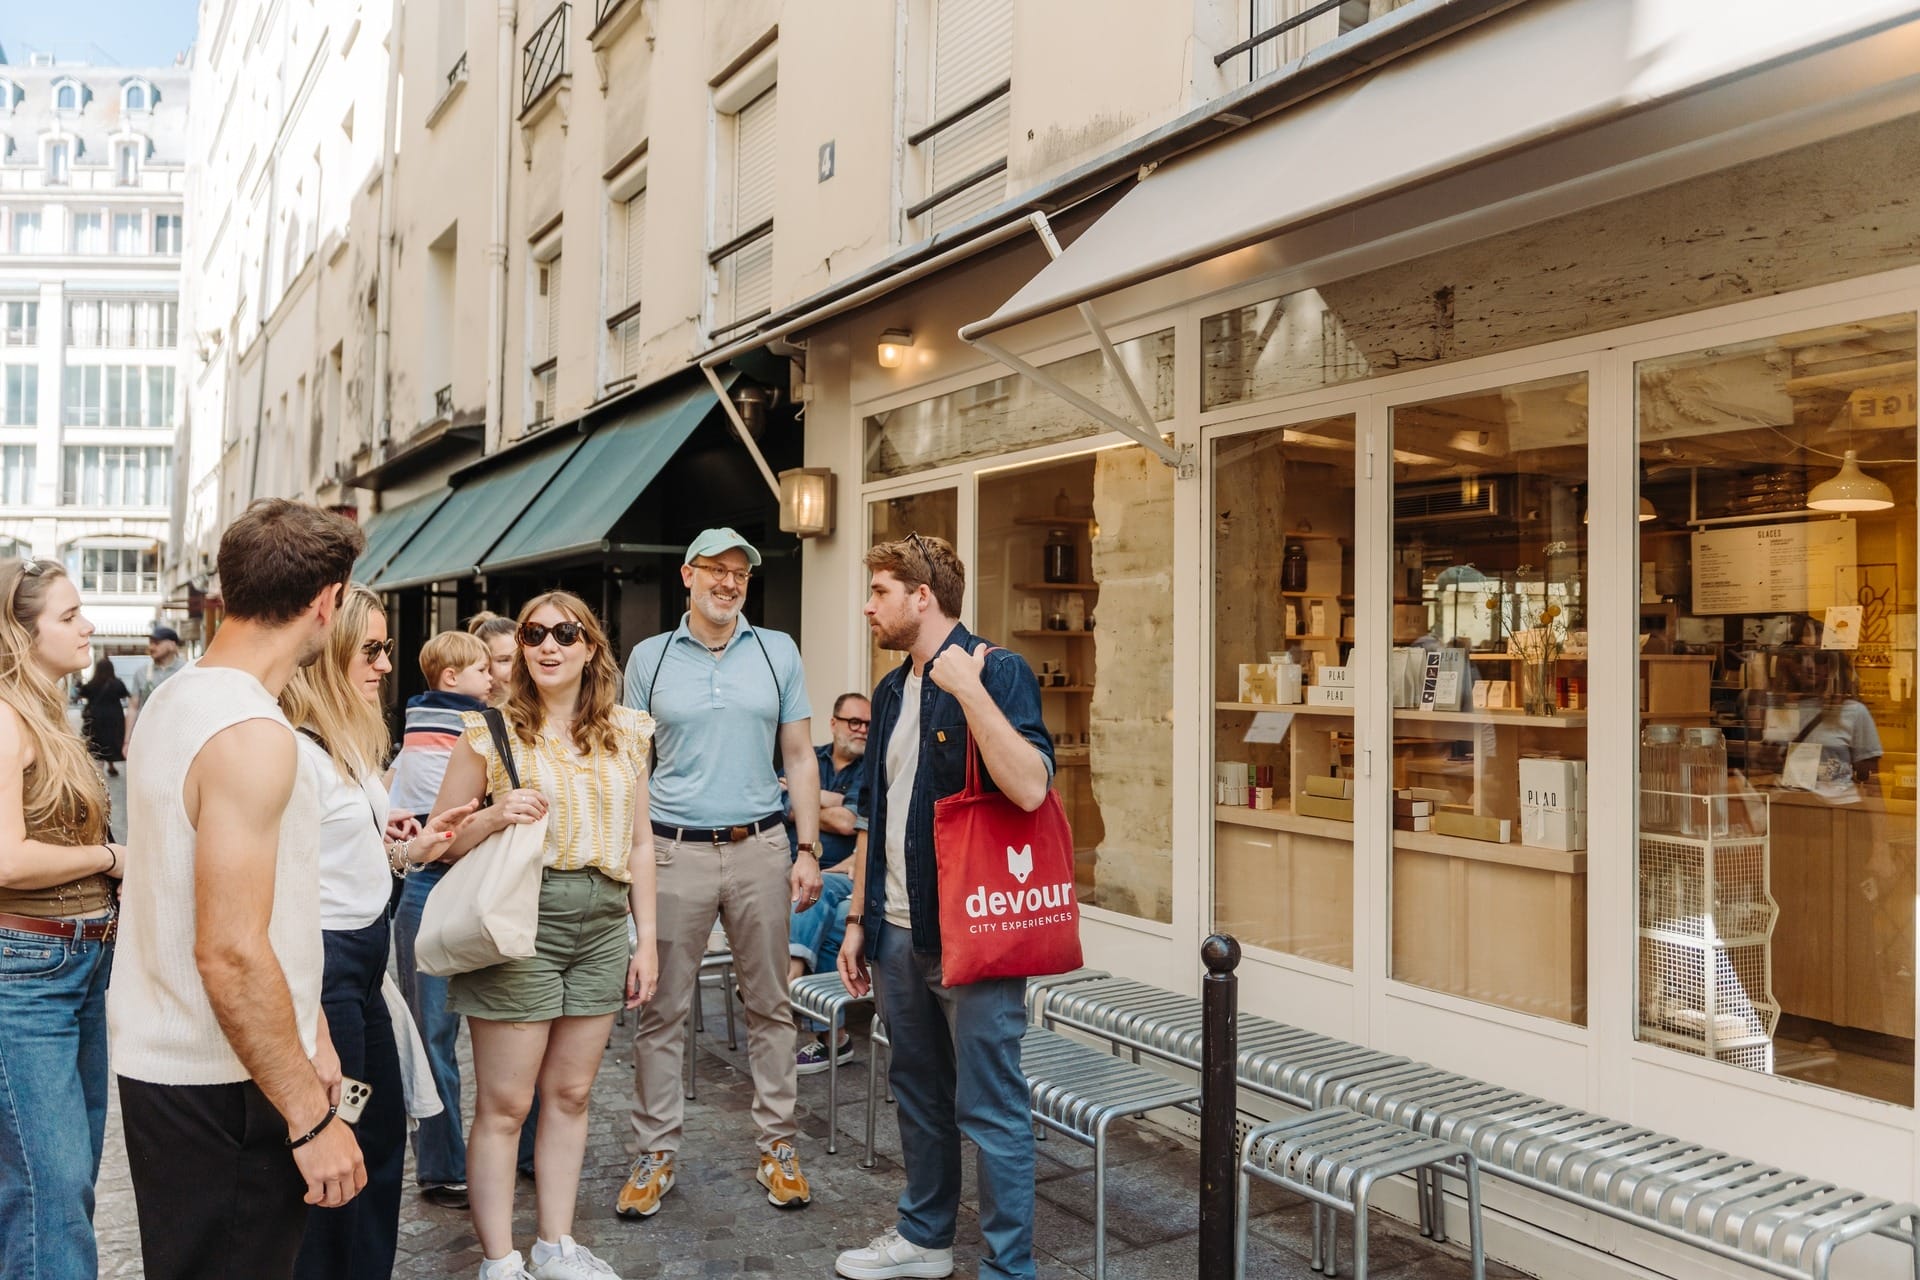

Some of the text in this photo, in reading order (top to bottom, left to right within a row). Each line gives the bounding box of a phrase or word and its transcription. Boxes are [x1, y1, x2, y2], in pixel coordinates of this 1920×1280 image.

[822, 147, 831, 176] 4
[1757, 529, 1782, 539] GLACES
[965, 882, 1072, 917] devour
[969, 912, 1072, 933] CITY EXPERIENCES
